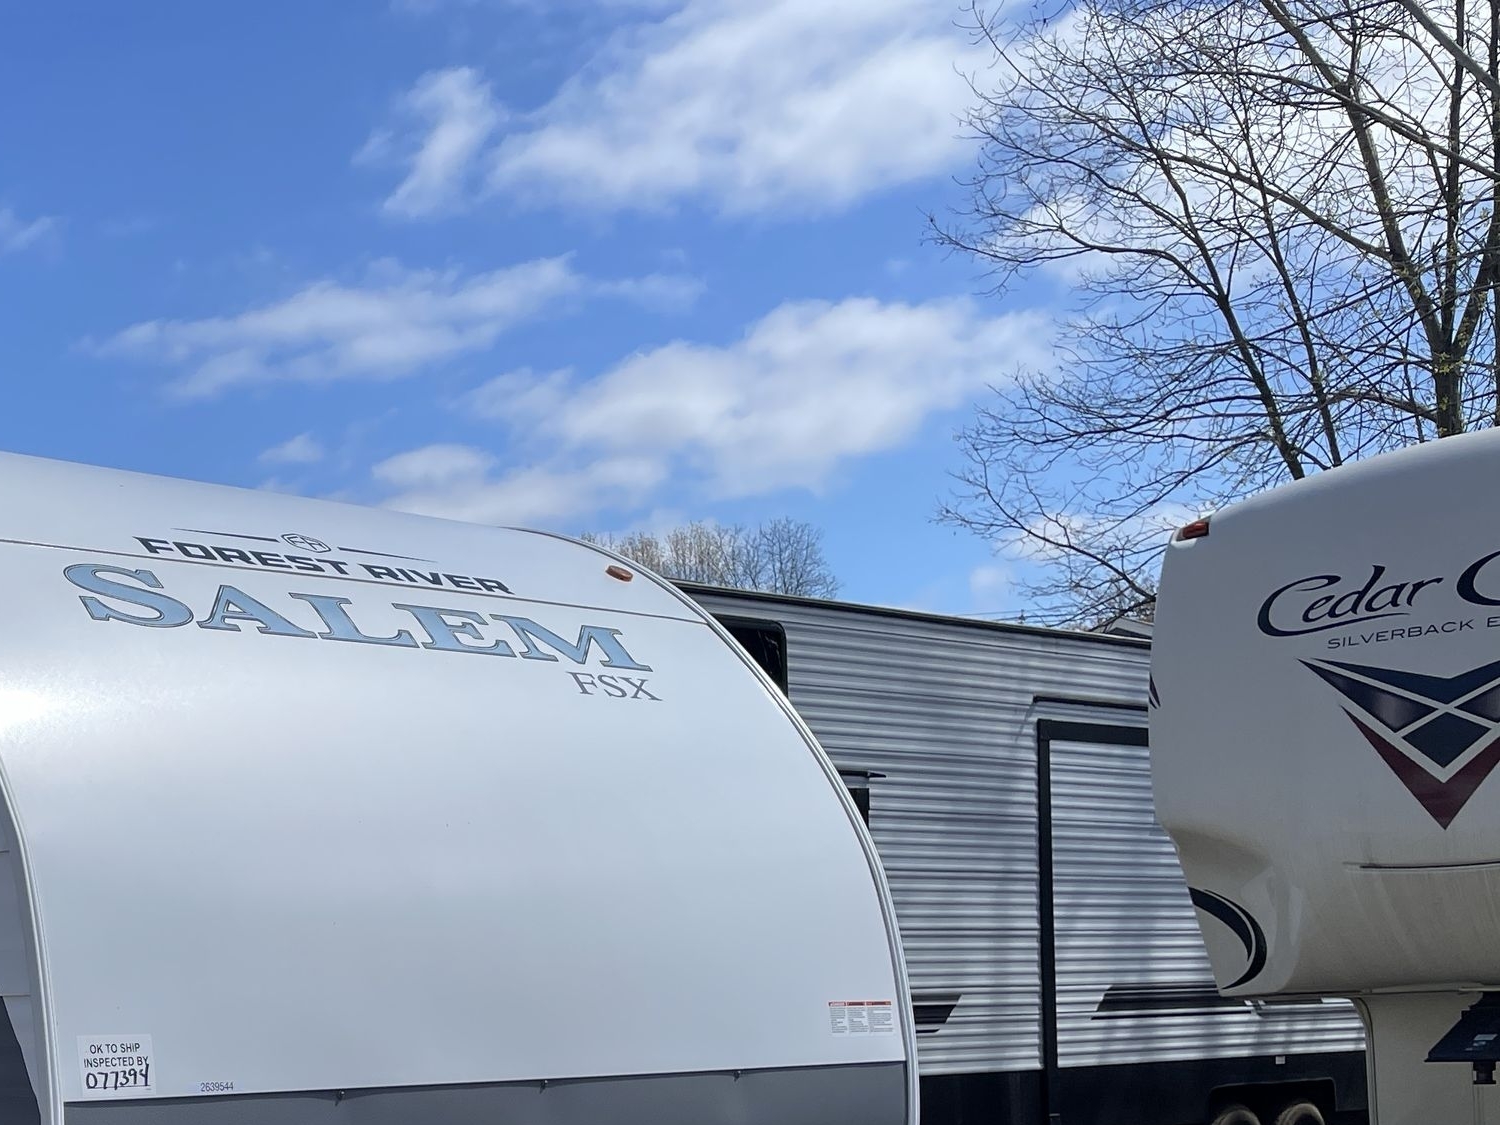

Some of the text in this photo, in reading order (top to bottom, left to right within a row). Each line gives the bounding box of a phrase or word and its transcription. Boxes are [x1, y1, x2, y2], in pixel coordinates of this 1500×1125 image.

[132, 536, 515, 595] FOREST RIVER
[1257, 565, 1443, 637] Cedar
[63, 563, 652, 671] SALEM
[1327, 618, 1474, 649] SILVERBACK
[564, 670, 663, 702] FSX
[83, 1056, 149, 1068] INSPECTED BY
[89, 1042, 141, 1054] OK TO SHIP
[85, 1064, 150, 1090] 077394
[200, 1081, 234, 1092] 2639544
